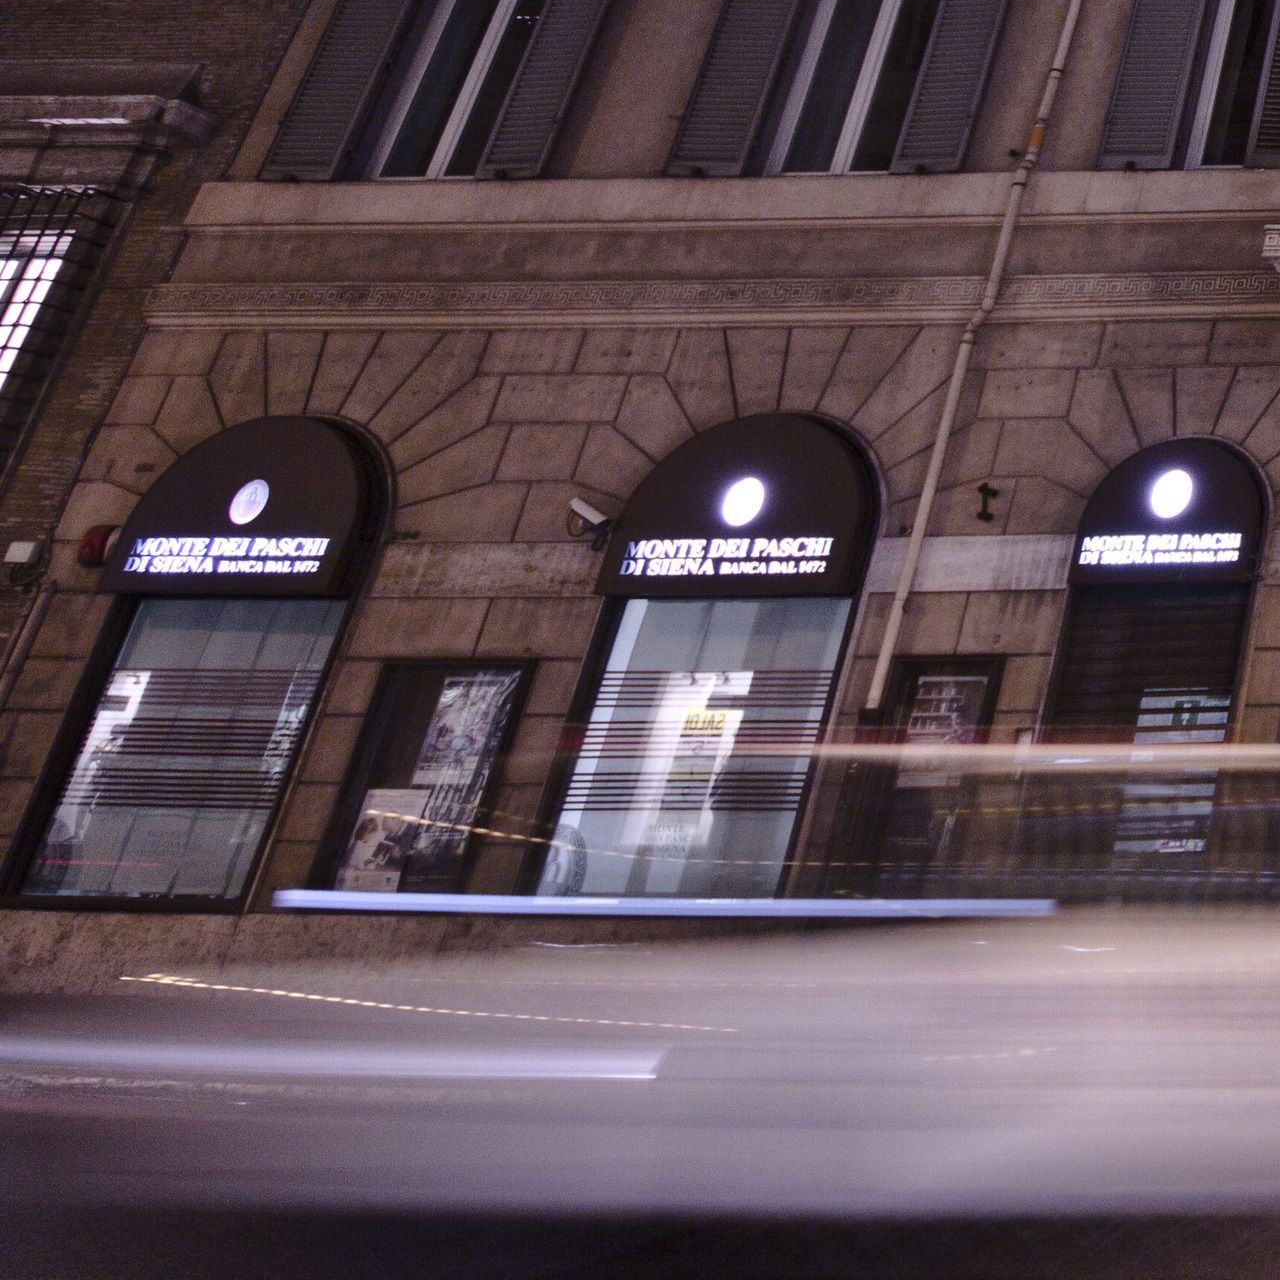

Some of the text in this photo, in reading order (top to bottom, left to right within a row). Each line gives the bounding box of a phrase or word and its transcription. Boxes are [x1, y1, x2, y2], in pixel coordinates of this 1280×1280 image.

[130, 537, 331, 556] MONTE DEI PASCHI
[624, 537, 834, 558] MONTE DEI PASCHI
[1082, 535, 1146, 551] MONTE
[123, 557, 150, 572] DI
[150, 556, 214, 572] SIENA
[264, 560, 292, 573] DAL
[1078, 551, 1100, 564] DI
[619, 559, 645, 575] DI
[646, 558, 715, 575] SIENA
[768, 561, 798, 574] DAL
